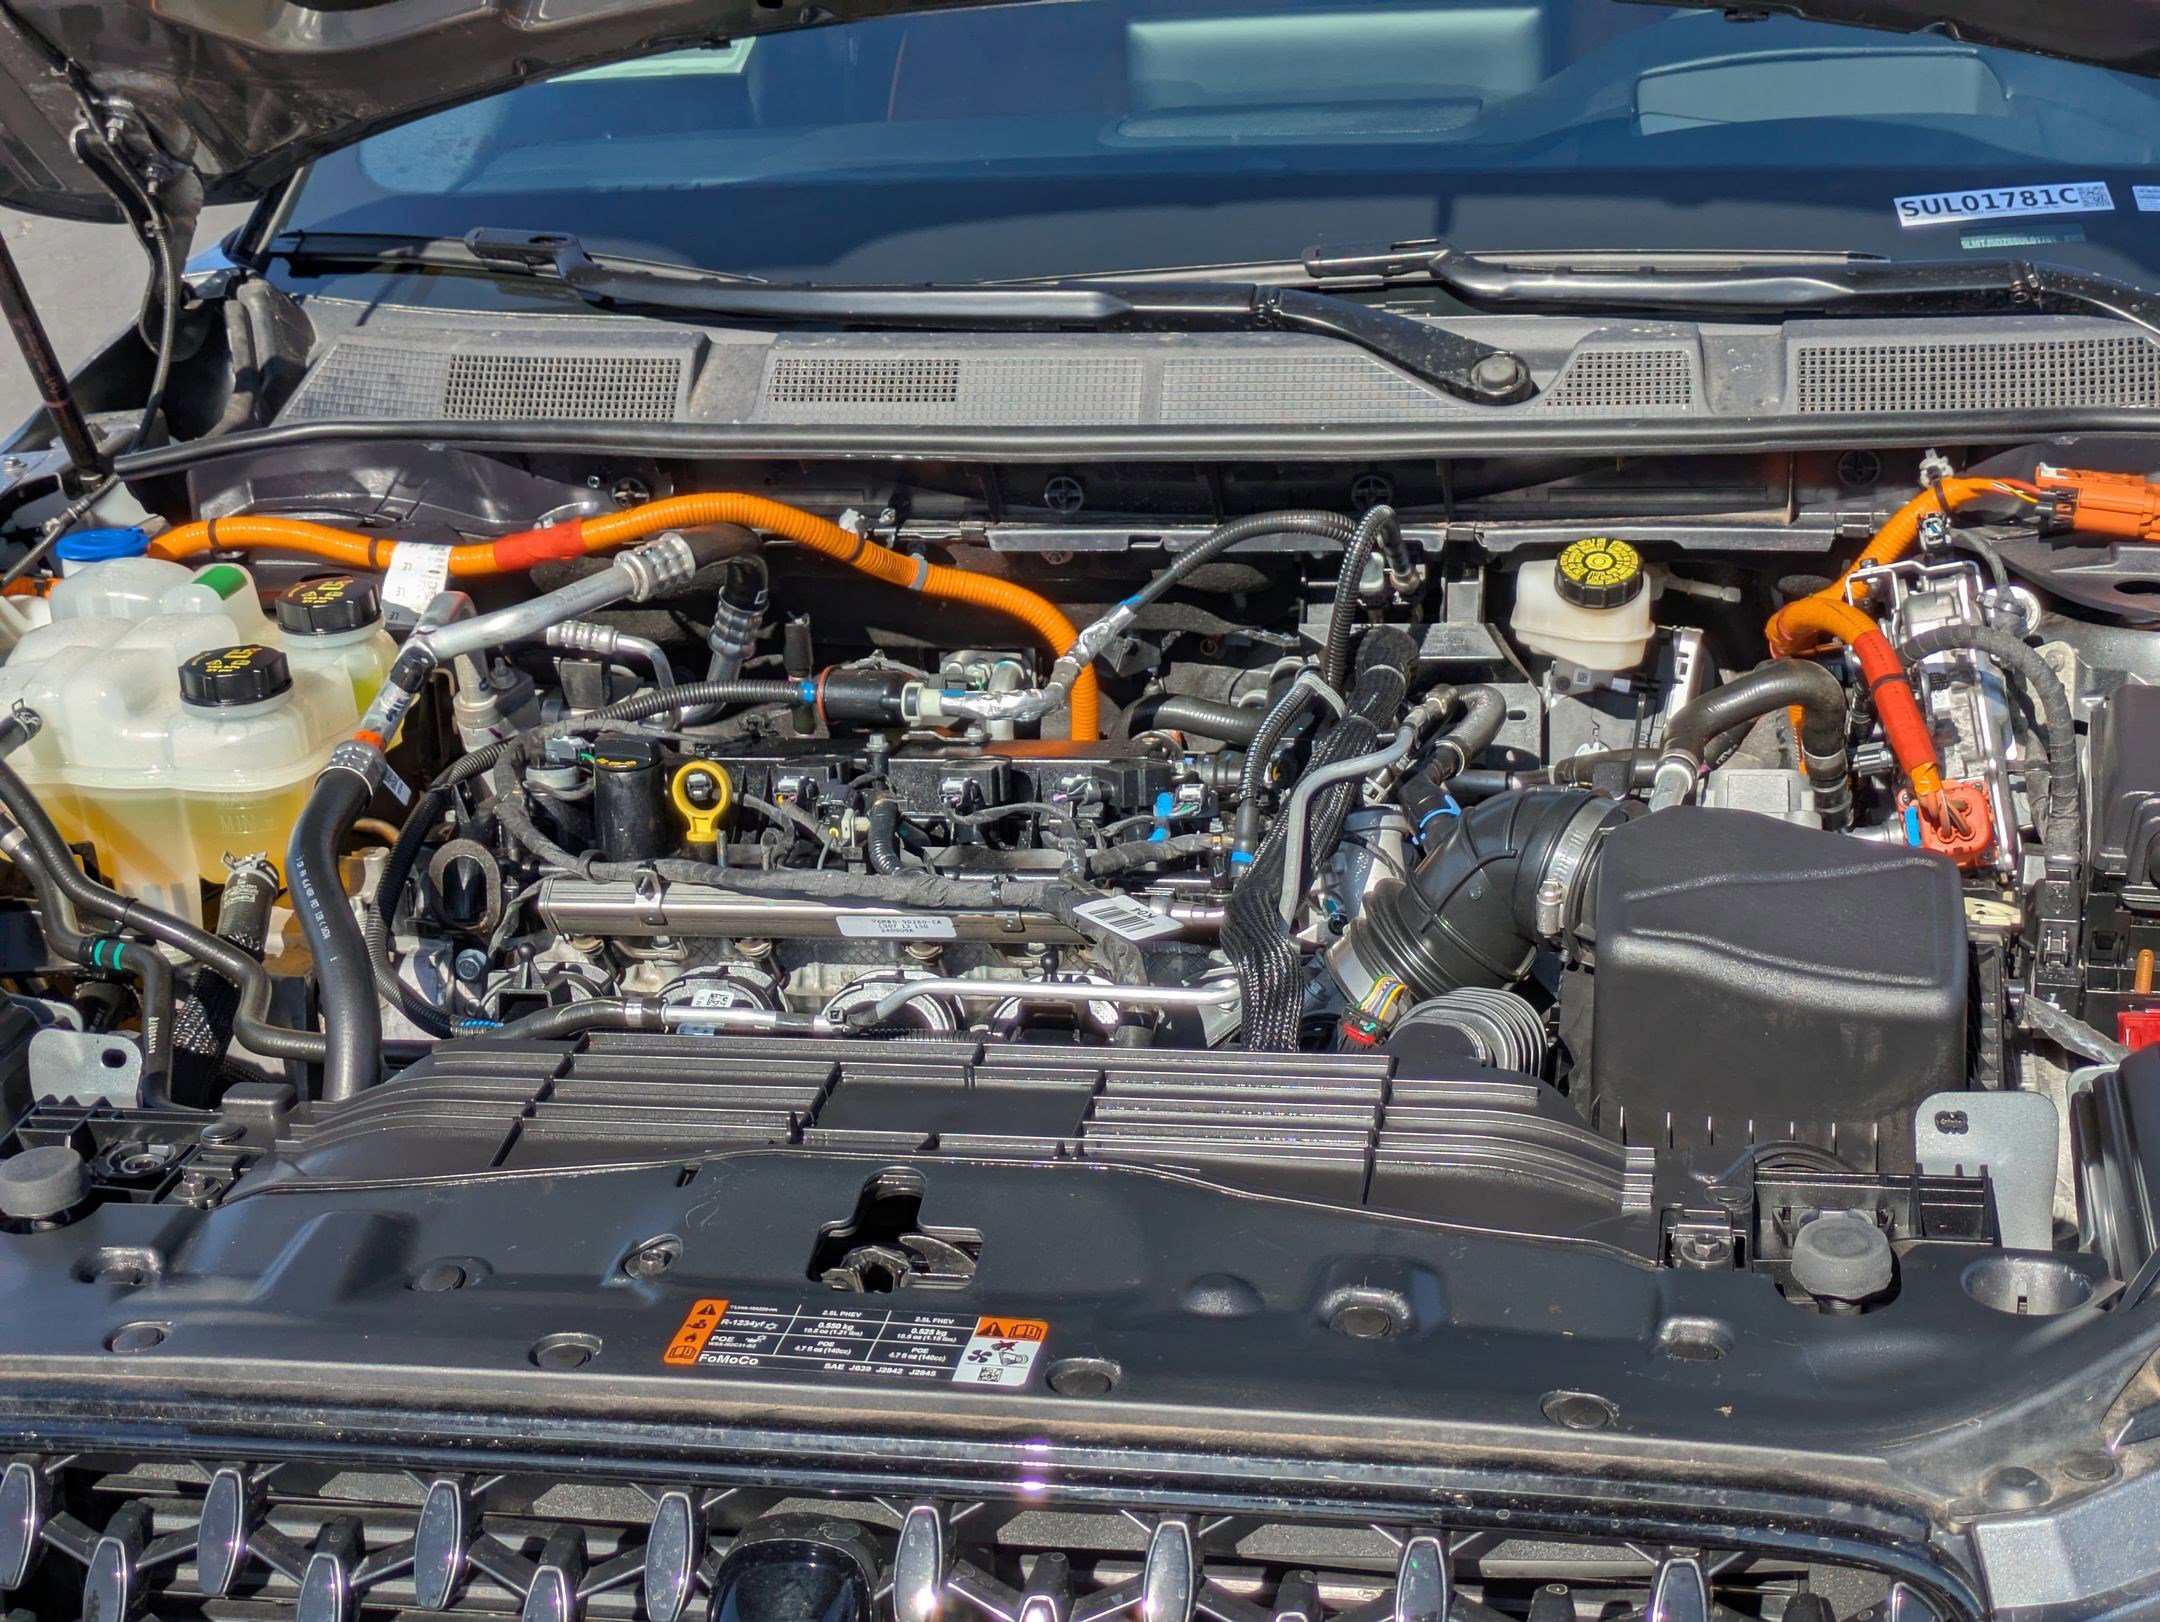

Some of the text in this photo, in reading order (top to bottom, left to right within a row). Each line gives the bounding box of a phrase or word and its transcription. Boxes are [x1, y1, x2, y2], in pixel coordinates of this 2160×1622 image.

[1901, 188, 2079, 217] SUL01781C
[720, 1319, 765, 1328] R-1234yf
[818, 1322, 855, 1331] 0.550 kg
[936, 1329, 948, 1337] kg
[711, 1335, 735, 1343] POE
[698, 1354, 759, 1365] FoMoCo
[824, 1362, 846, 1370] SAE
